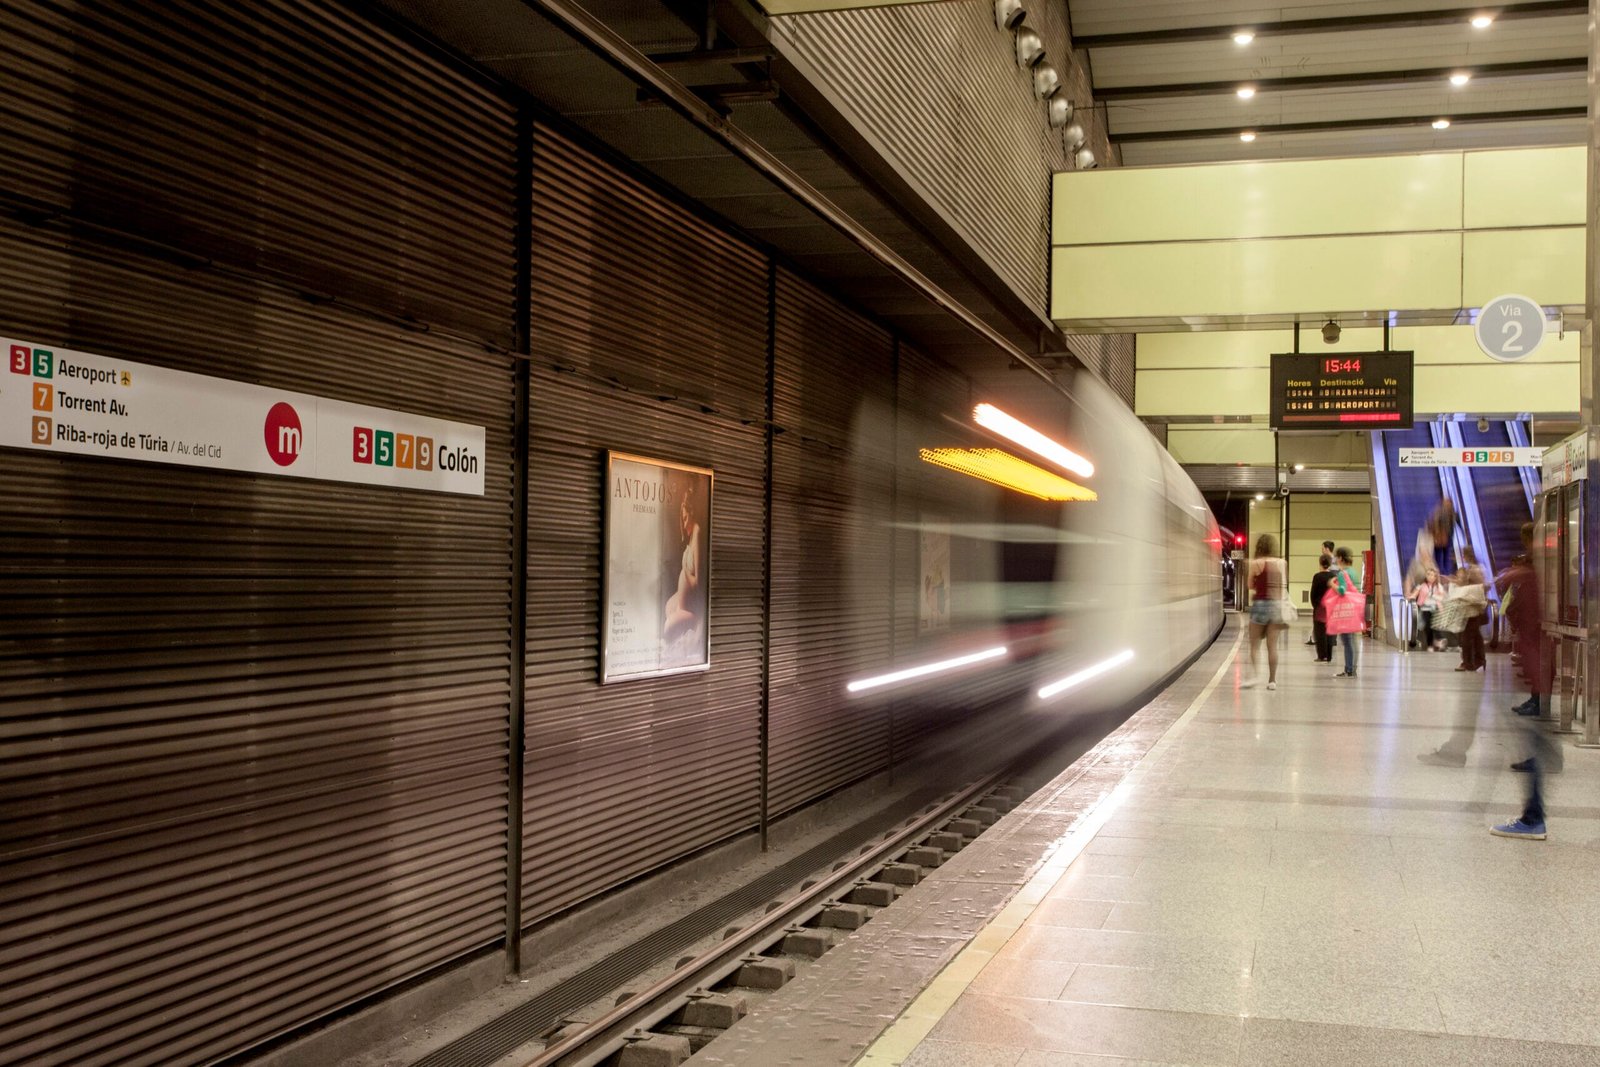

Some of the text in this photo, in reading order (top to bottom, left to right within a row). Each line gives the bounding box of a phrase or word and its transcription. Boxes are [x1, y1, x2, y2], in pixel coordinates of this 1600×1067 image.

[1500, 305, 1521, 317] Via
[1501, 320, 1523, 352] 2
[15, 349, 117, 385] 3 5 Aeroport
[1325, 359, 1360, 373] 15:44
[1320, 378, 1364, 387] Destinació
[1384, 378, 1397, 386] Via
[38, 387, 129, 417] 7 Torrent Av.
[37, 421, 222, 459] 9 Riba-roja de Túria / Av. del Cid
[358, 433, 478, 474] 3 5 7 9 Colón
[1465, 453, 1471, 462] 3
[1478, 453, 1485, 462] 5
[1491, 453, 1498, 462] 7
[1504, 453, 1511, 462] 9
[614, 477, 673, 503] ANTOJOS
